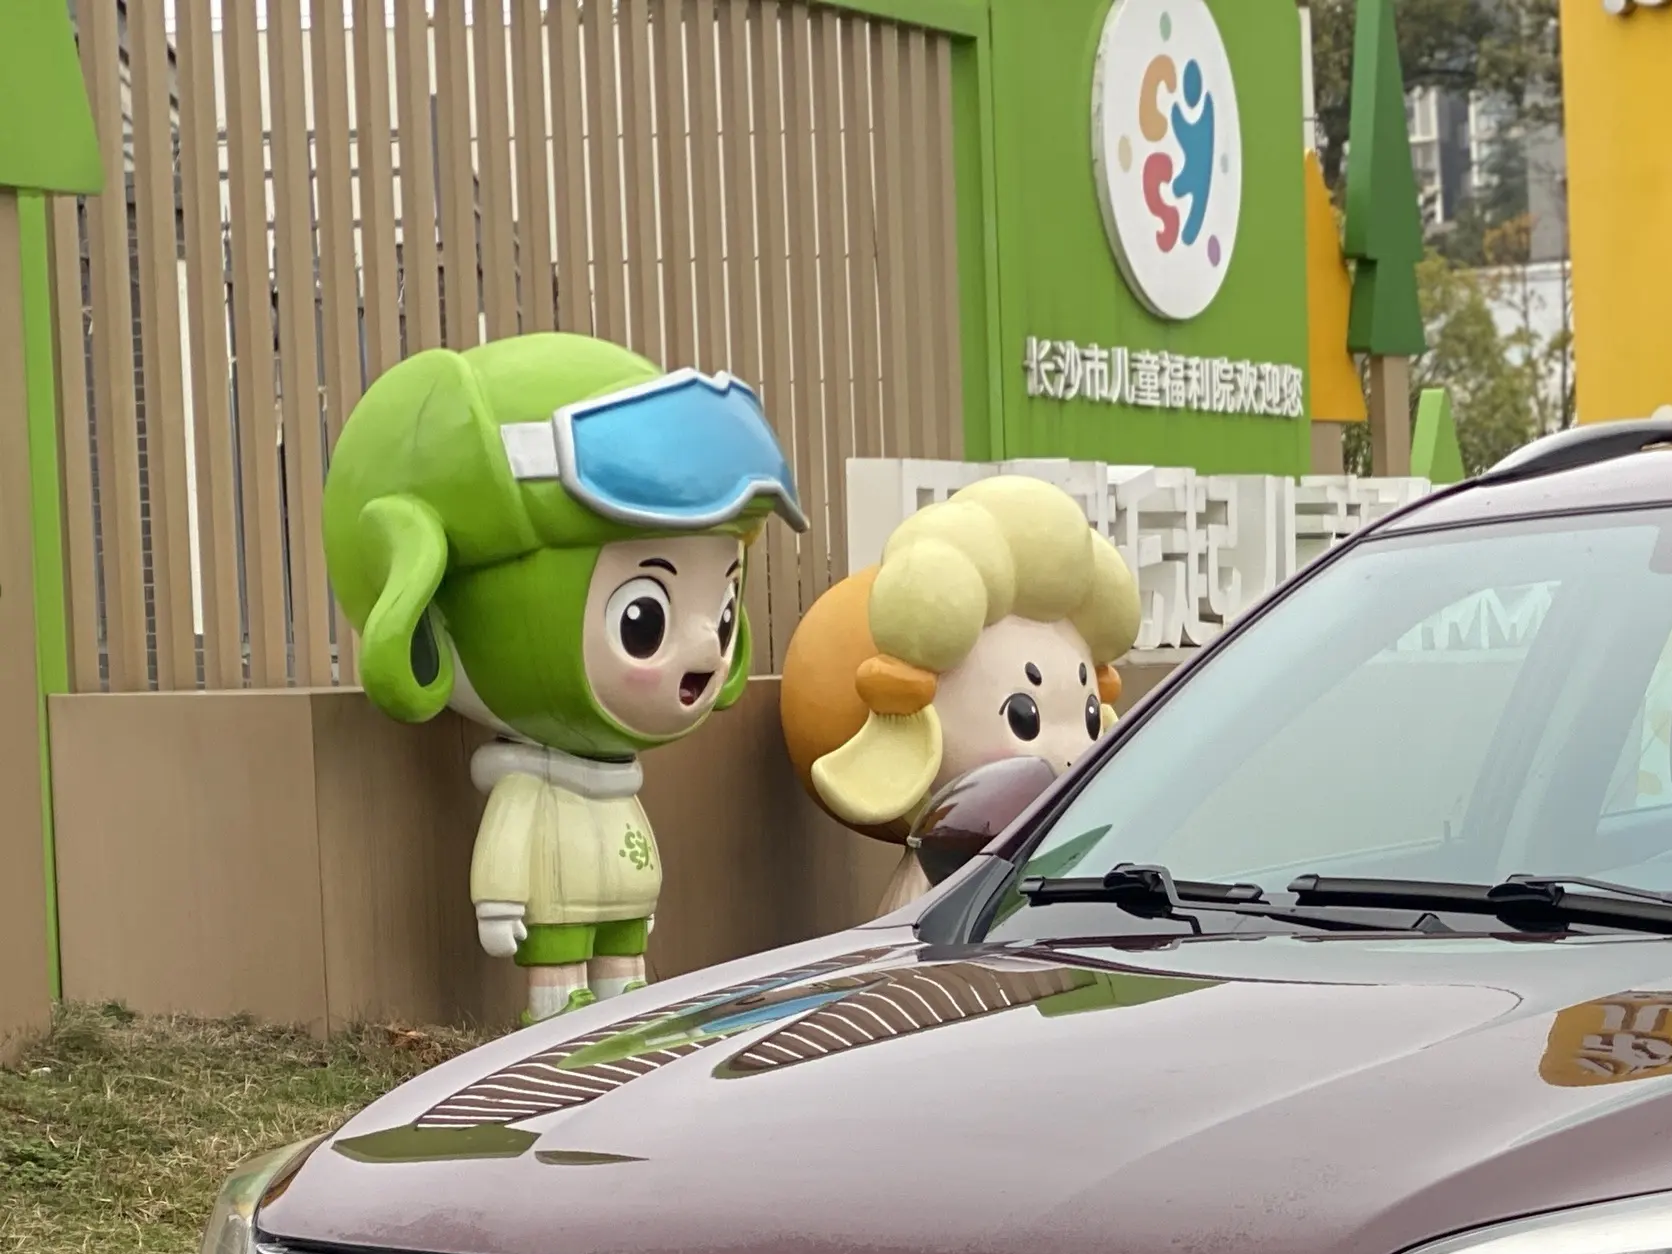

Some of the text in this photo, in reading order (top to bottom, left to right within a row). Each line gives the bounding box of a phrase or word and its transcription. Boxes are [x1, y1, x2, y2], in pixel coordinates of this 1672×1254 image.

[1023, 336, 1304, 417] 长沙市儿童福利院欢迎您
